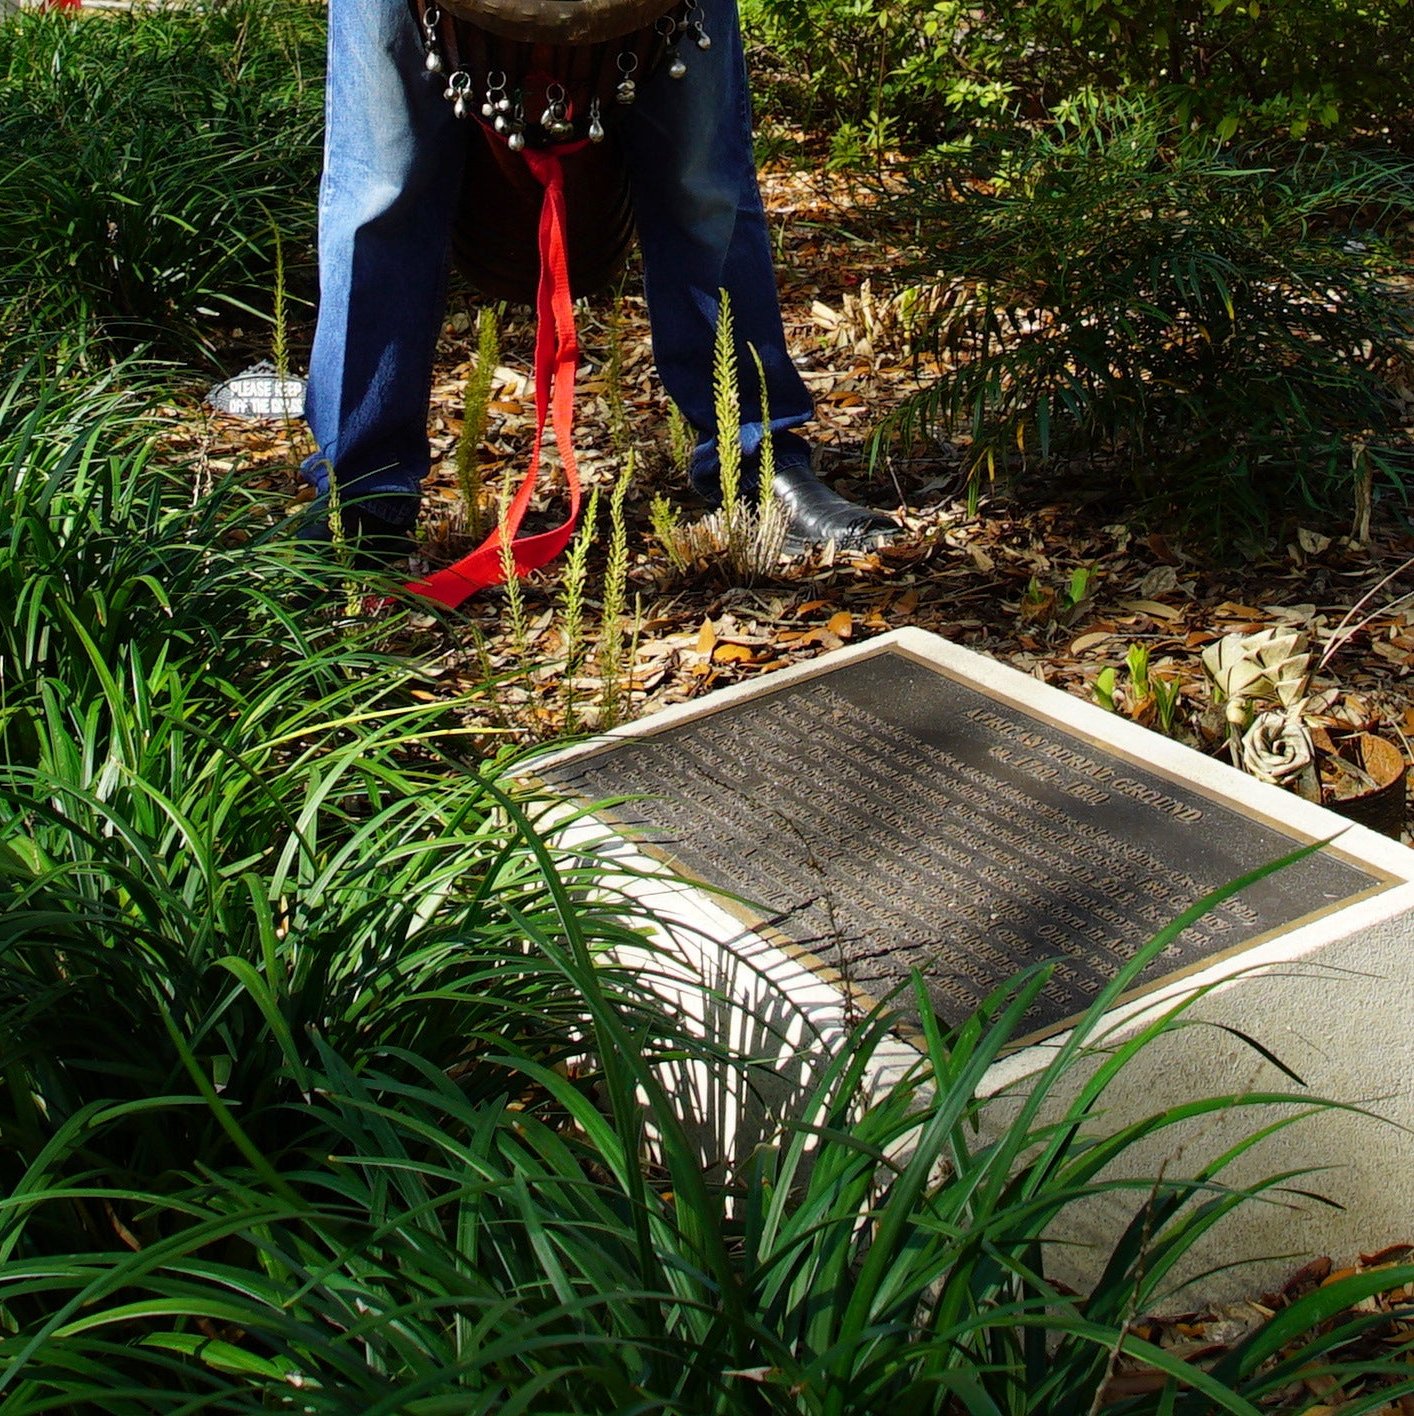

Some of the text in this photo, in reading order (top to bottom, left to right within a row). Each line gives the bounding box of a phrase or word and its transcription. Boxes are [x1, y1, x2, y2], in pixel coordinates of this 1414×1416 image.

[229, 381, 272, 397] PLEASE
[250, 398, 270, 413] THE
[962, 706, 1207, 823] AFRICAN BURIAL GROUND
